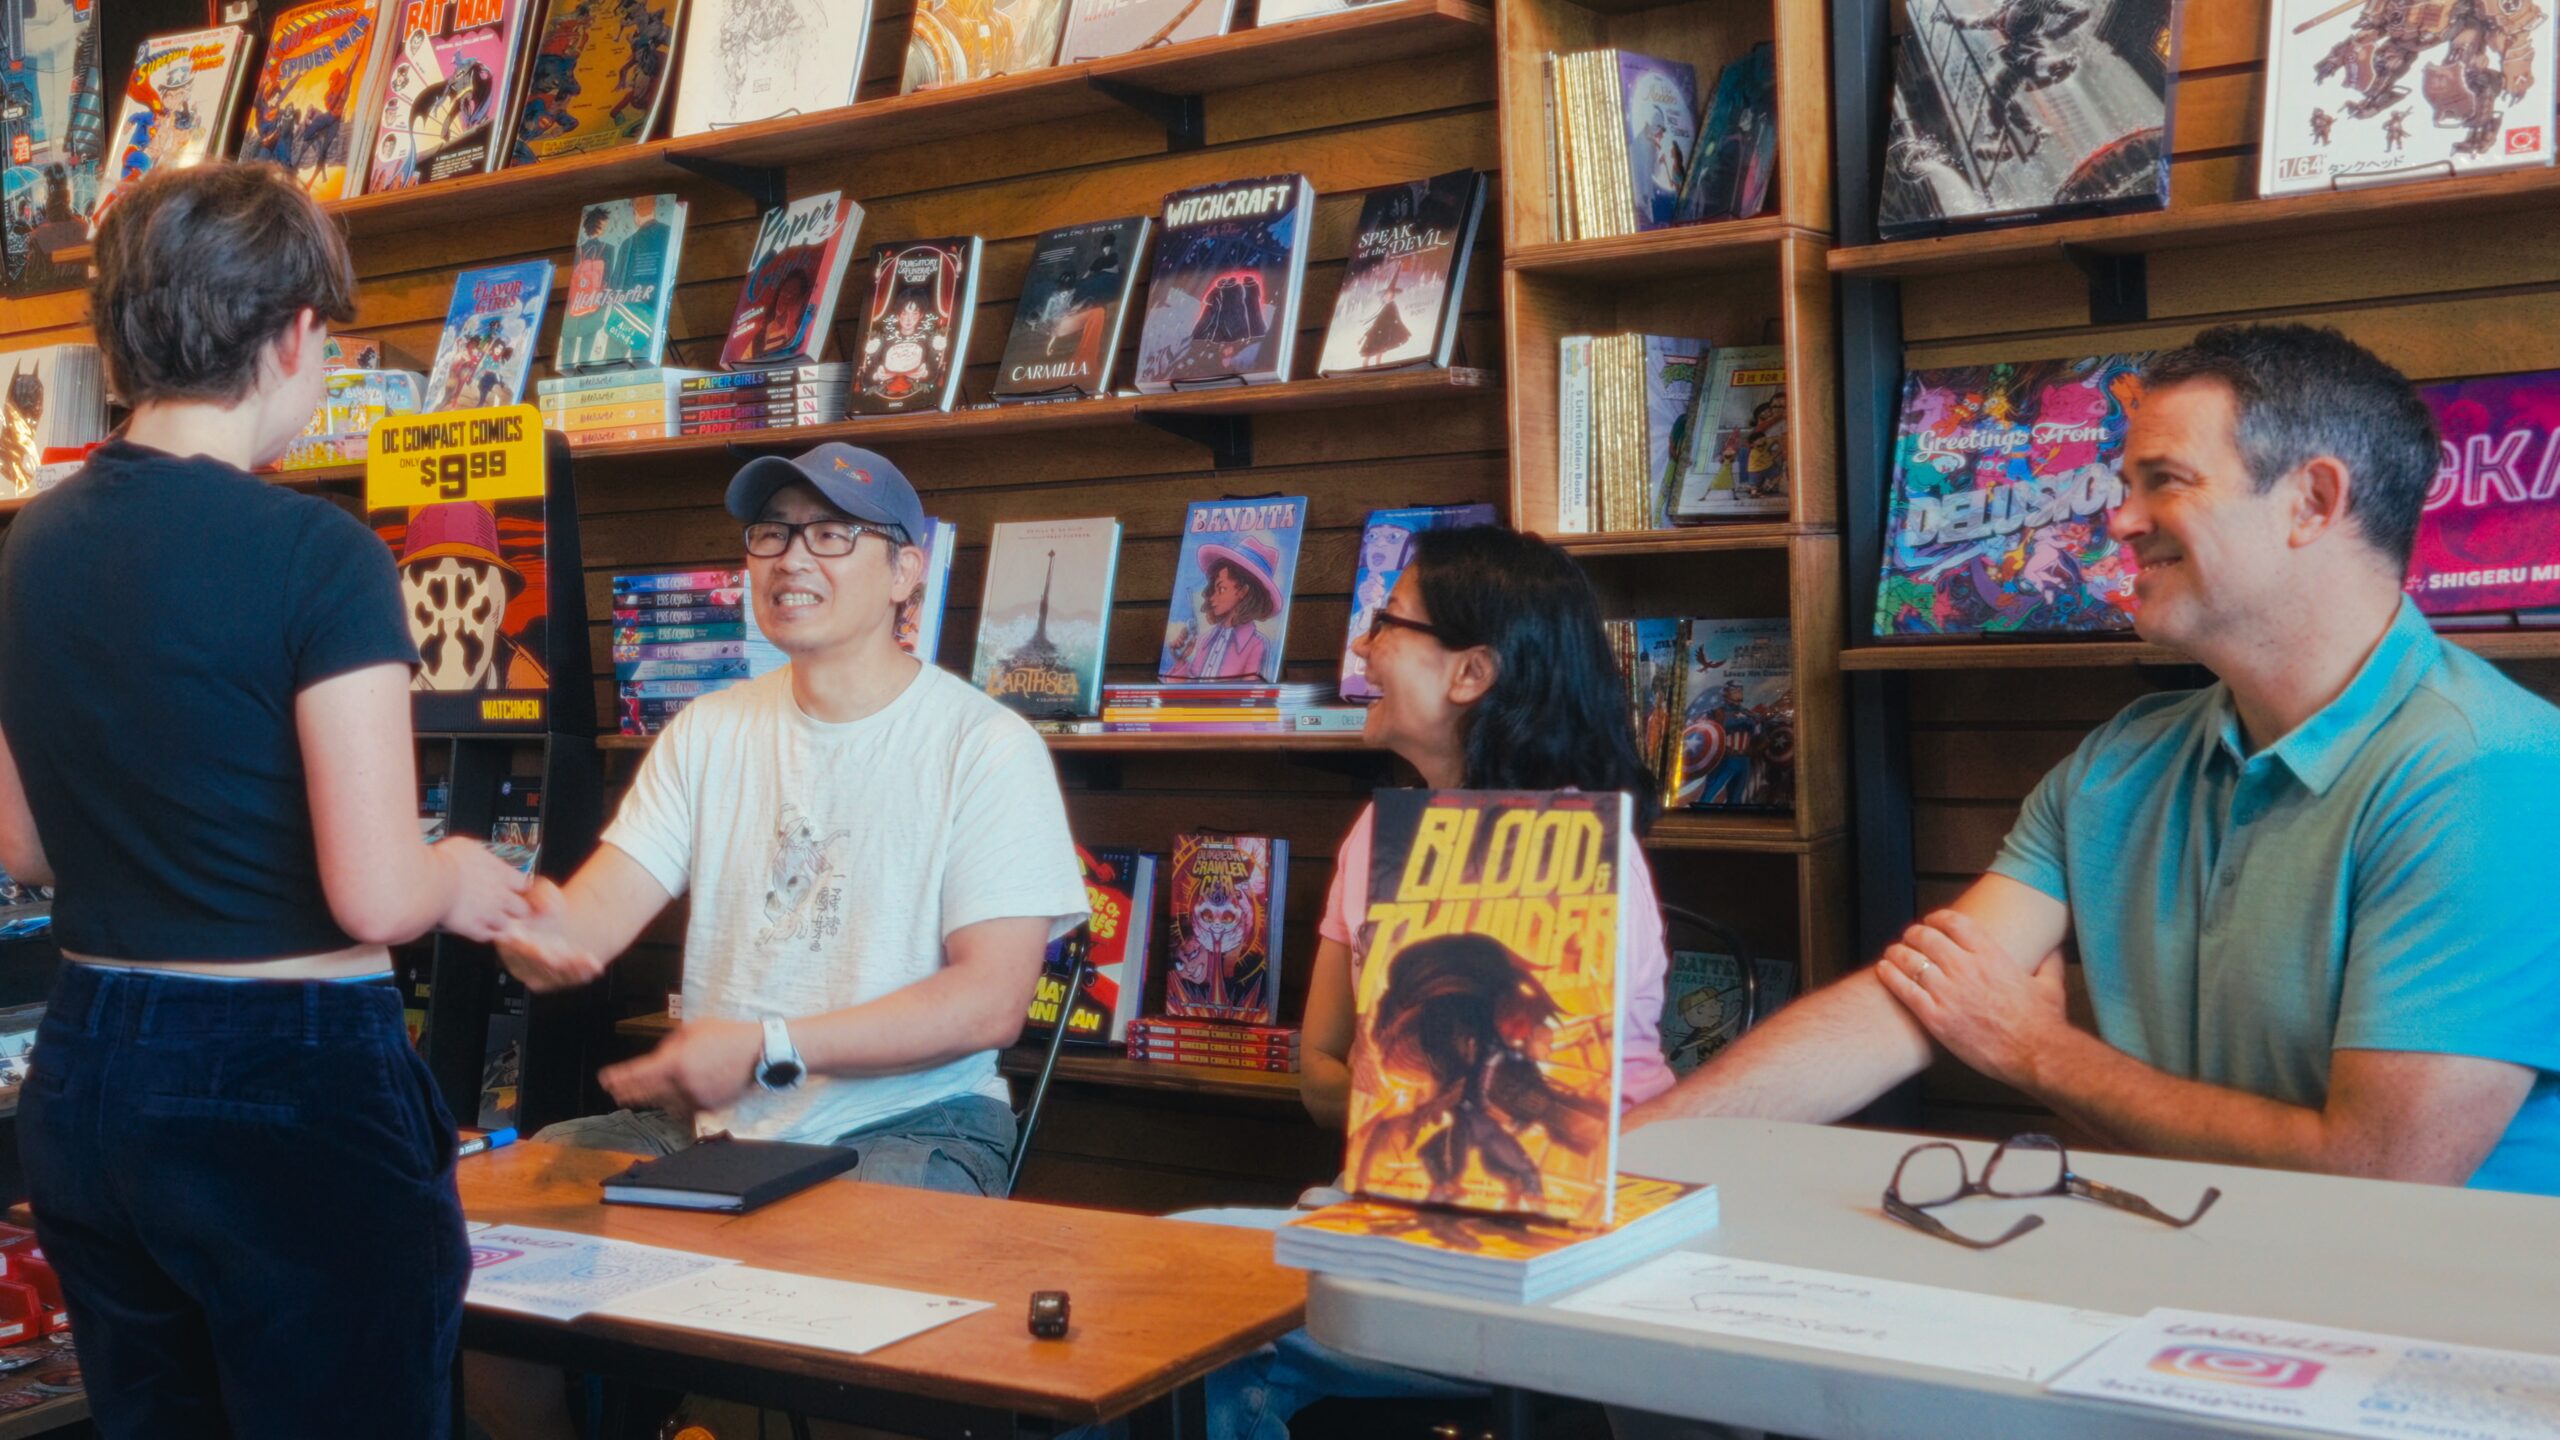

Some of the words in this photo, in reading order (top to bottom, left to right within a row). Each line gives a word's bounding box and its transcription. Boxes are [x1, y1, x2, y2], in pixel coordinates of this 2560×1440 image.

[402, 0, 450, 43] BAT
[453, 0, 504, 32] MAN
[2279, 155, 2324, 179] 1/64
[751, 199, 835, 268] Paper
[1359, 223, 1413, 248] SPEAK
[1386, 229, 1450, 257] DEVIL
[473, 280, 523, 301] FLAVOR
[573, 285, 655, 312] HEARTSTOPPER
[475, 295, 517, 314] GIRLS
[698, 375, 732, 390] PAPER
[734, 372, 766, 386] GIRLS
[1011, 361, 1089, 382] CARMILLA
[698, 408, 732, 421] PAPER
[382, 428, 400, 455] DC
[403, 421, 467, 452] COMPACT
[470, 415, 524, 446] COMICS
[1912, 427, 2029, 472] Greetings
[2031, 419, 2109, 444] From
[400, 457, 421, 469] ONLY
[1190, 503, 1297, 533] BANDITA
[2429, 566, 2528, 589] SHIGERU
[986, 665, 1079, 699] EARTHSEA
[482, 700, 540, 721] WATCHMEN
[1399, 807, 1604, 897] BLOOD
[1192, 860, 1249, 878] CRAWLER
